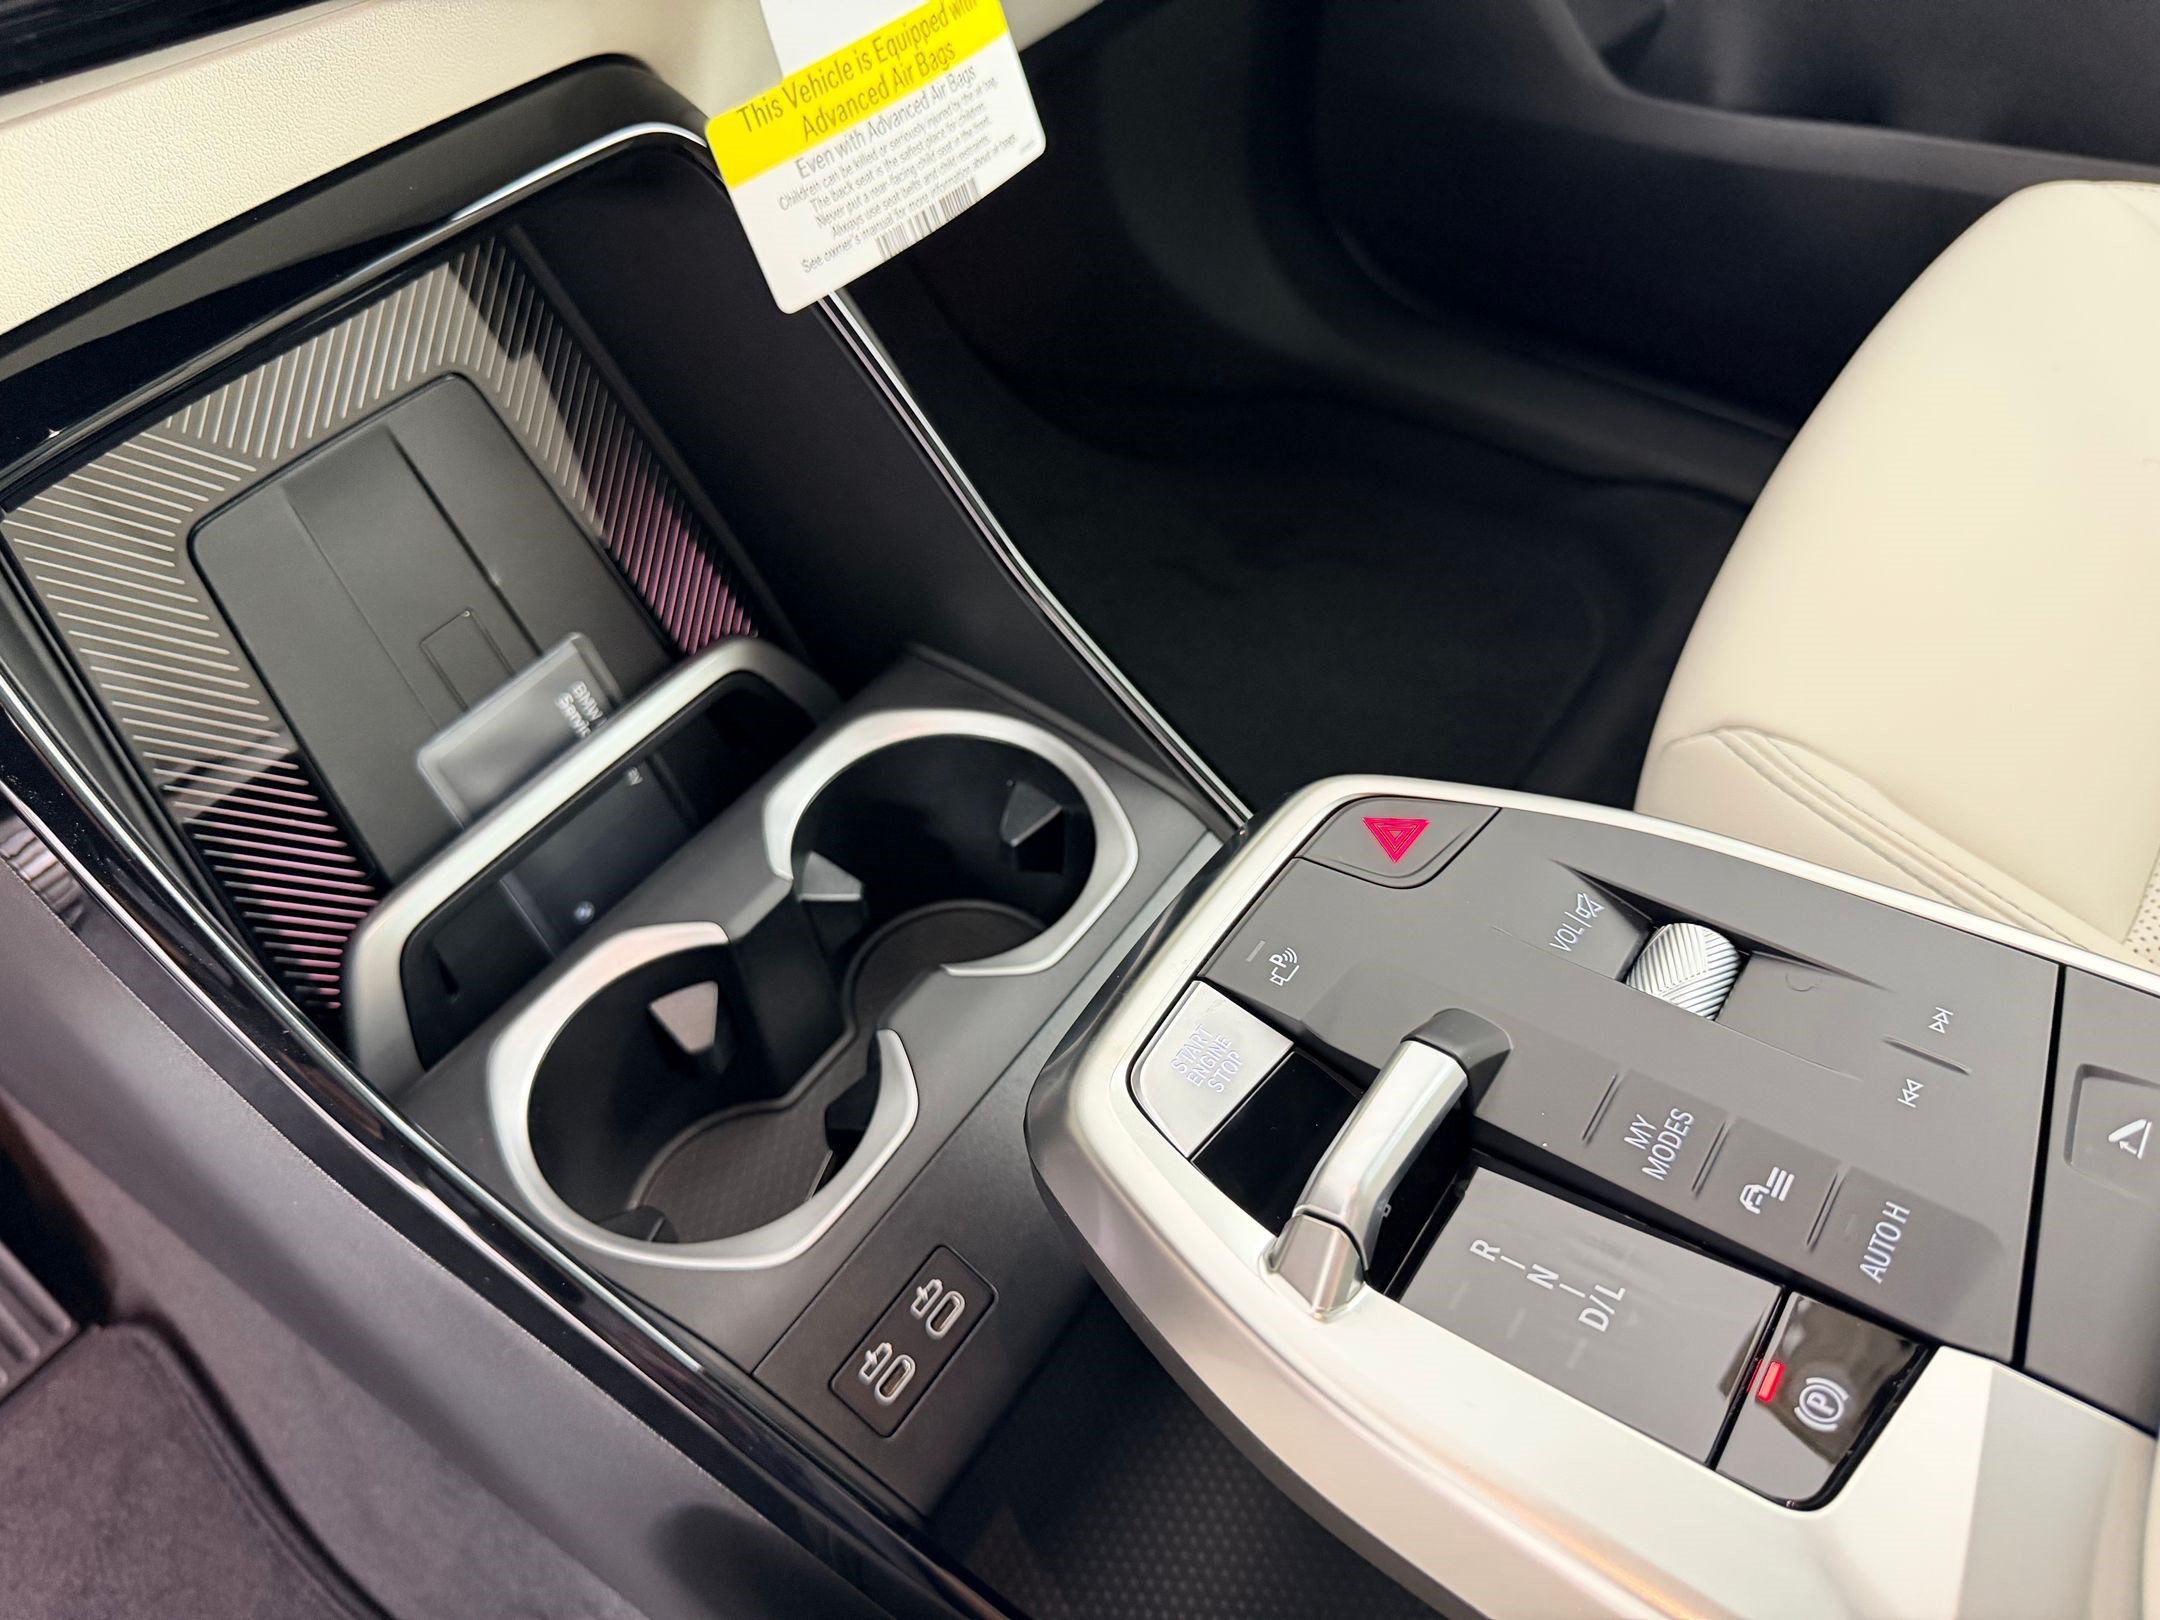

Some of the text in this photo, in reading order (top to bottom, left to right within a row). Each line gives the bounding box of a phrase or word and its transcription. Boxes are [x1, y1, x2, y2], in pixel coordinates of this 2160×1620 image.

[737, 101, 783, 133] This
[782, 60, 855, 110] Vehicle
[854, 50, 873, 75] is
[872, 2, 948, 63] Equipped
[803, 42, 955, 142] Advanced Air Bags
[794, 65, 975, 178] Even with Advanced Air Bags
[778, 181, 821, 209] Children
[809, 194, 831, 211] The
[801, 256, 823, 272] See
[1170, 1023, 1213, 1073] START
[1186, 1034, 1232, 1087] ENGINE
[1208, 1050, 1243, 1093] STOP
[1623, 1113, 1657, 1150] MY
[1641, 1107, 1695, 1181] MODES
[1470, 1239, 1501, 1262] R
[1859, 1201, 1911, 1285] AUTO H
[1526, 1263, 1559, 1290] N
[1578, 1284, 1626, 1332] D/L
